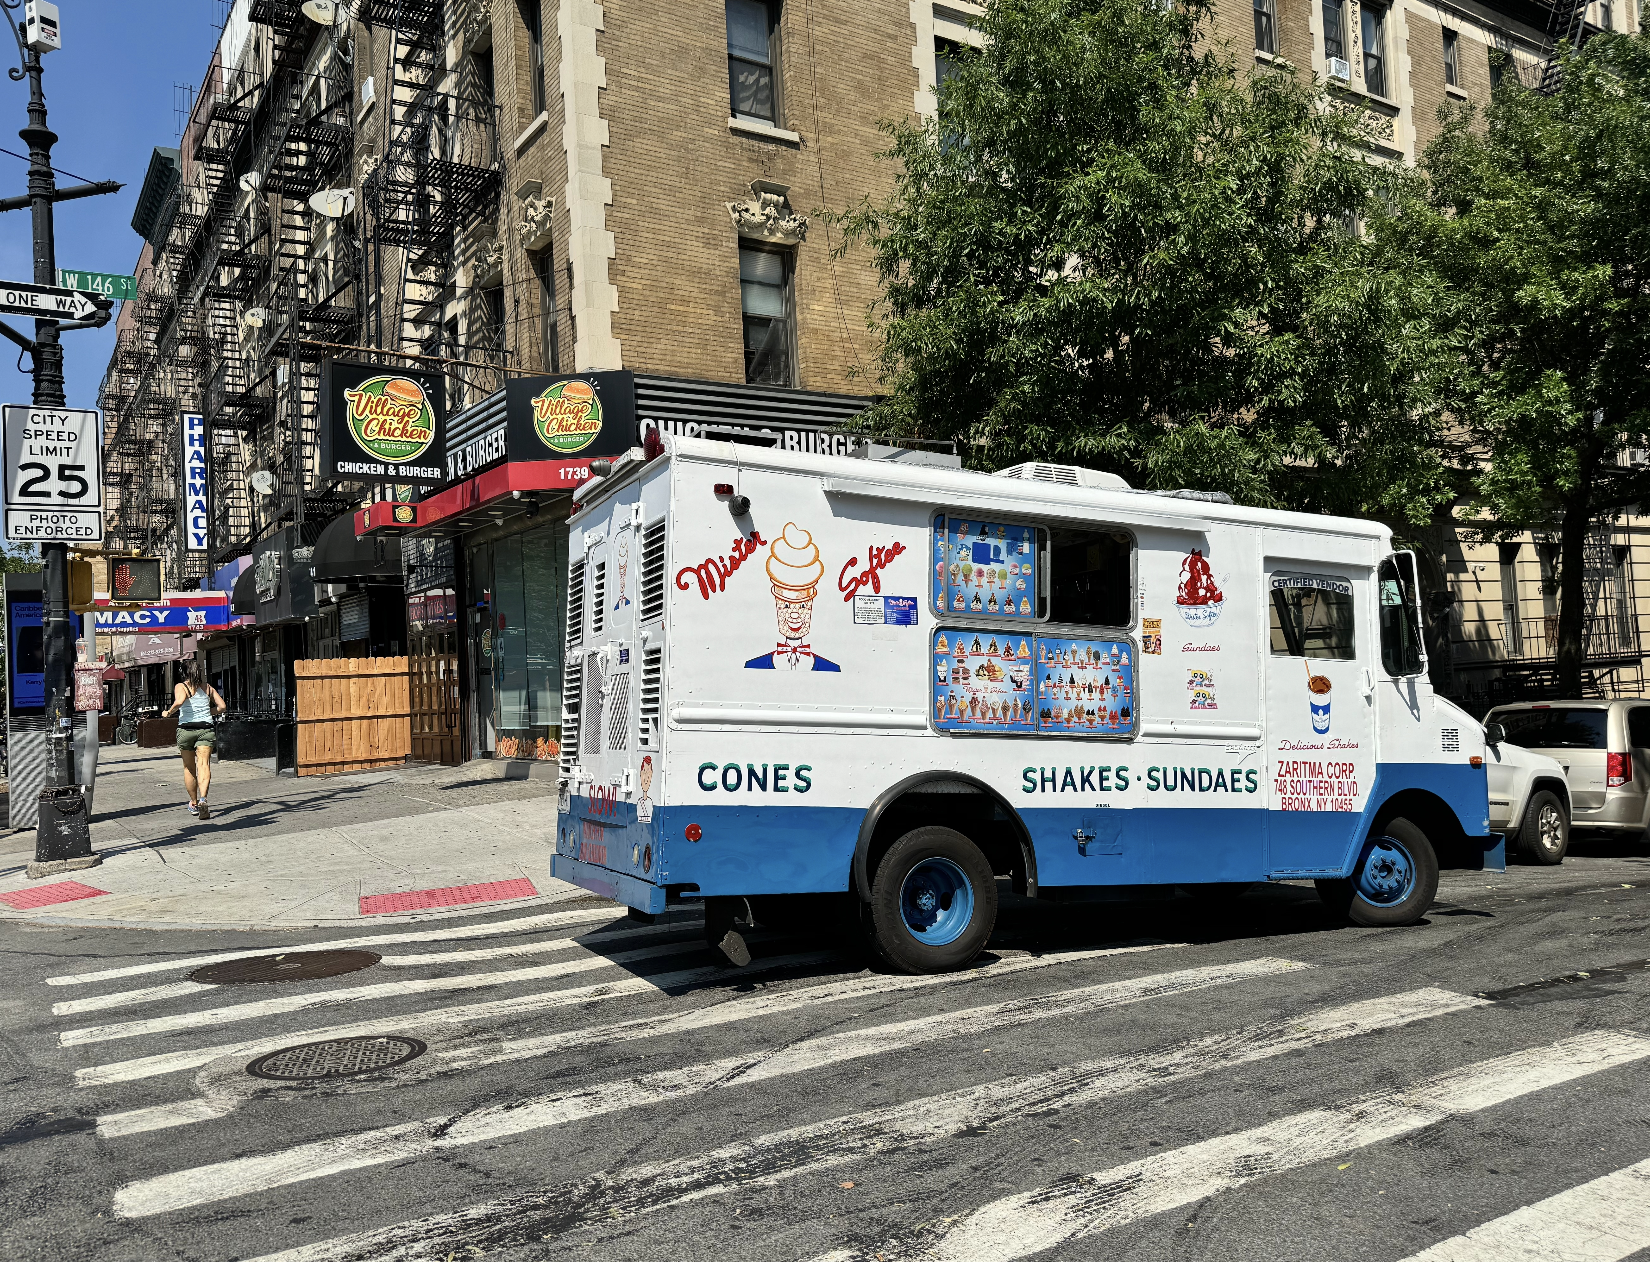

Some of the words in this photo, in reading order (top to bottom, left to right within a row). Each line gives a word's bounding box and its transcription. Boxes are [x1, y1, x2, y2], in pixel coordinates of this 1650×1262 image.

[65, 272, 79, 290] W
[87, 275, 113, 294] 146
[120, 278, 132, 290] St
[6, 292, 40, 307] ONE
[55, 297, 89, 312] WAY
[344, 389, 420, 424] Village
[533, 397, 591, 421] Village
[30, 413, 70, 427] CITY
[363, 416, 432, 441] Chicken
[545, 414, 600, 435] Chicken
[22, 428, 78, 442] SPEED
[29, 444, 73, 458] LIMIT
[380, 443, 412, 451] BURGER
[456, 450, 465, 477] &
[465, 428, 506, 472] BURGER
[337, 461, 386, 475] CHICKEN
[387, 464, 397, 476] &
[398, 465, 442, 479] BURGER
[558, 467, 589, 480] 1739
[17, 461, 89, 500] 25
[187, 416, 208, 547] PHARMACY
[29, 514, 78, 525] PHOTO
[14, 525, 94, 537] ENFORCED
[676, 531, 768, 600] Mister
[837, 541, 907, 602] Softee
[1271, 577, 1315, 589] CERTIFIED
[1314, 579, 1350, 595] VENDOR
[1181, 642, 1221, 652] Sundaes
[1277, 739, 1325, 751] Delicious
[1326, 738, 1359, 750] Shakes
[697, 761, 813, 793] CONES
[1021, 765, 1130, 793] SHAKES
[1146, 765, 1259, 793] SUNDAES
[1277, 760, 1324, 778] ZARITMA
[1326, 761, 1356, 780] CORP.
[1273, 778, 1288, 796] 748
[1289, 779, 1335, 797] SOUTHERN
[1337, 780, 1360, 797] BLVD.
[587, 784, 618, 818] SLOW!
[1281, 796, 1314, 813] BRONX,
[1316, 797, 1328, 812] NY
[1330, 797, 1353, 812] 10455
